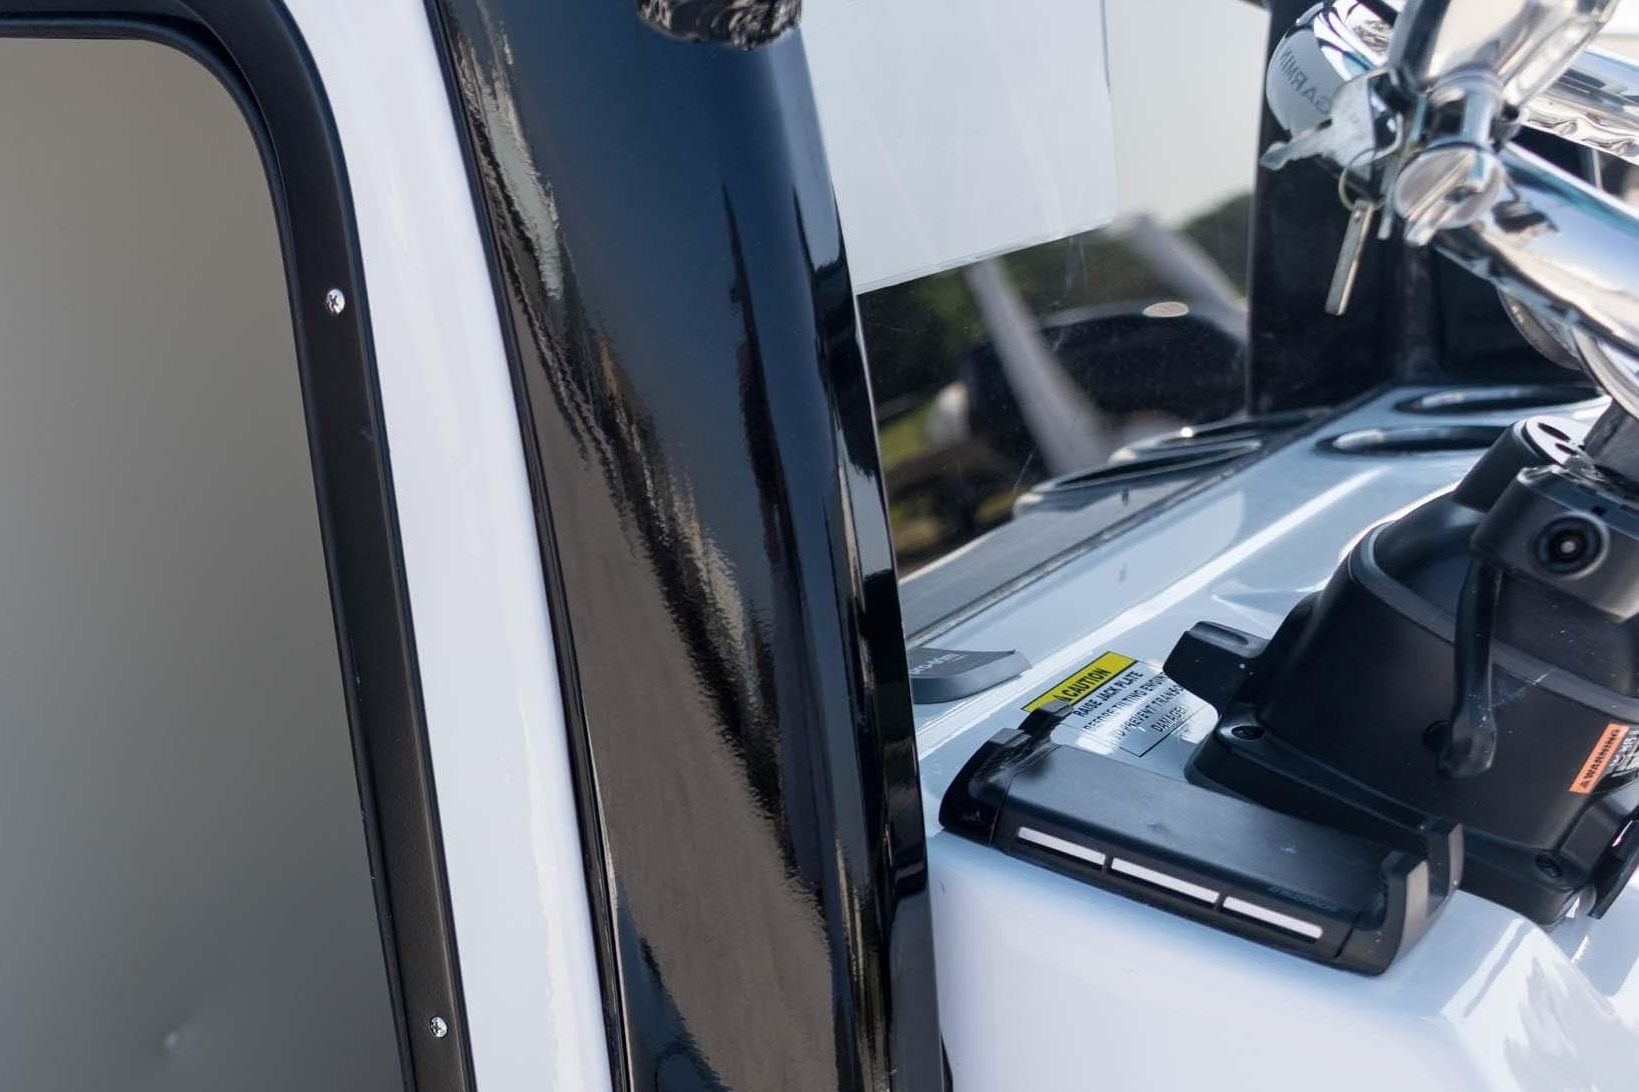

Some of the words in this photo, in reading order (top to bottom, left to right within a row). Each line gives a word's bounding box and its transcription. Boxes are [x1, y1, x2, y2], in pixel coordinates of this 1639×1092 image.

[1062, 667, 1112, 700] CAUTION
[1073, 698, 1103, 718] RAISE
[1098, 685, 1122, 705] JACK
[1116, 669, 1144, 690] PLATE
[1140, 671, 1168, 696] ENGIN
[1583, 729, 1620, 779] WARNING
